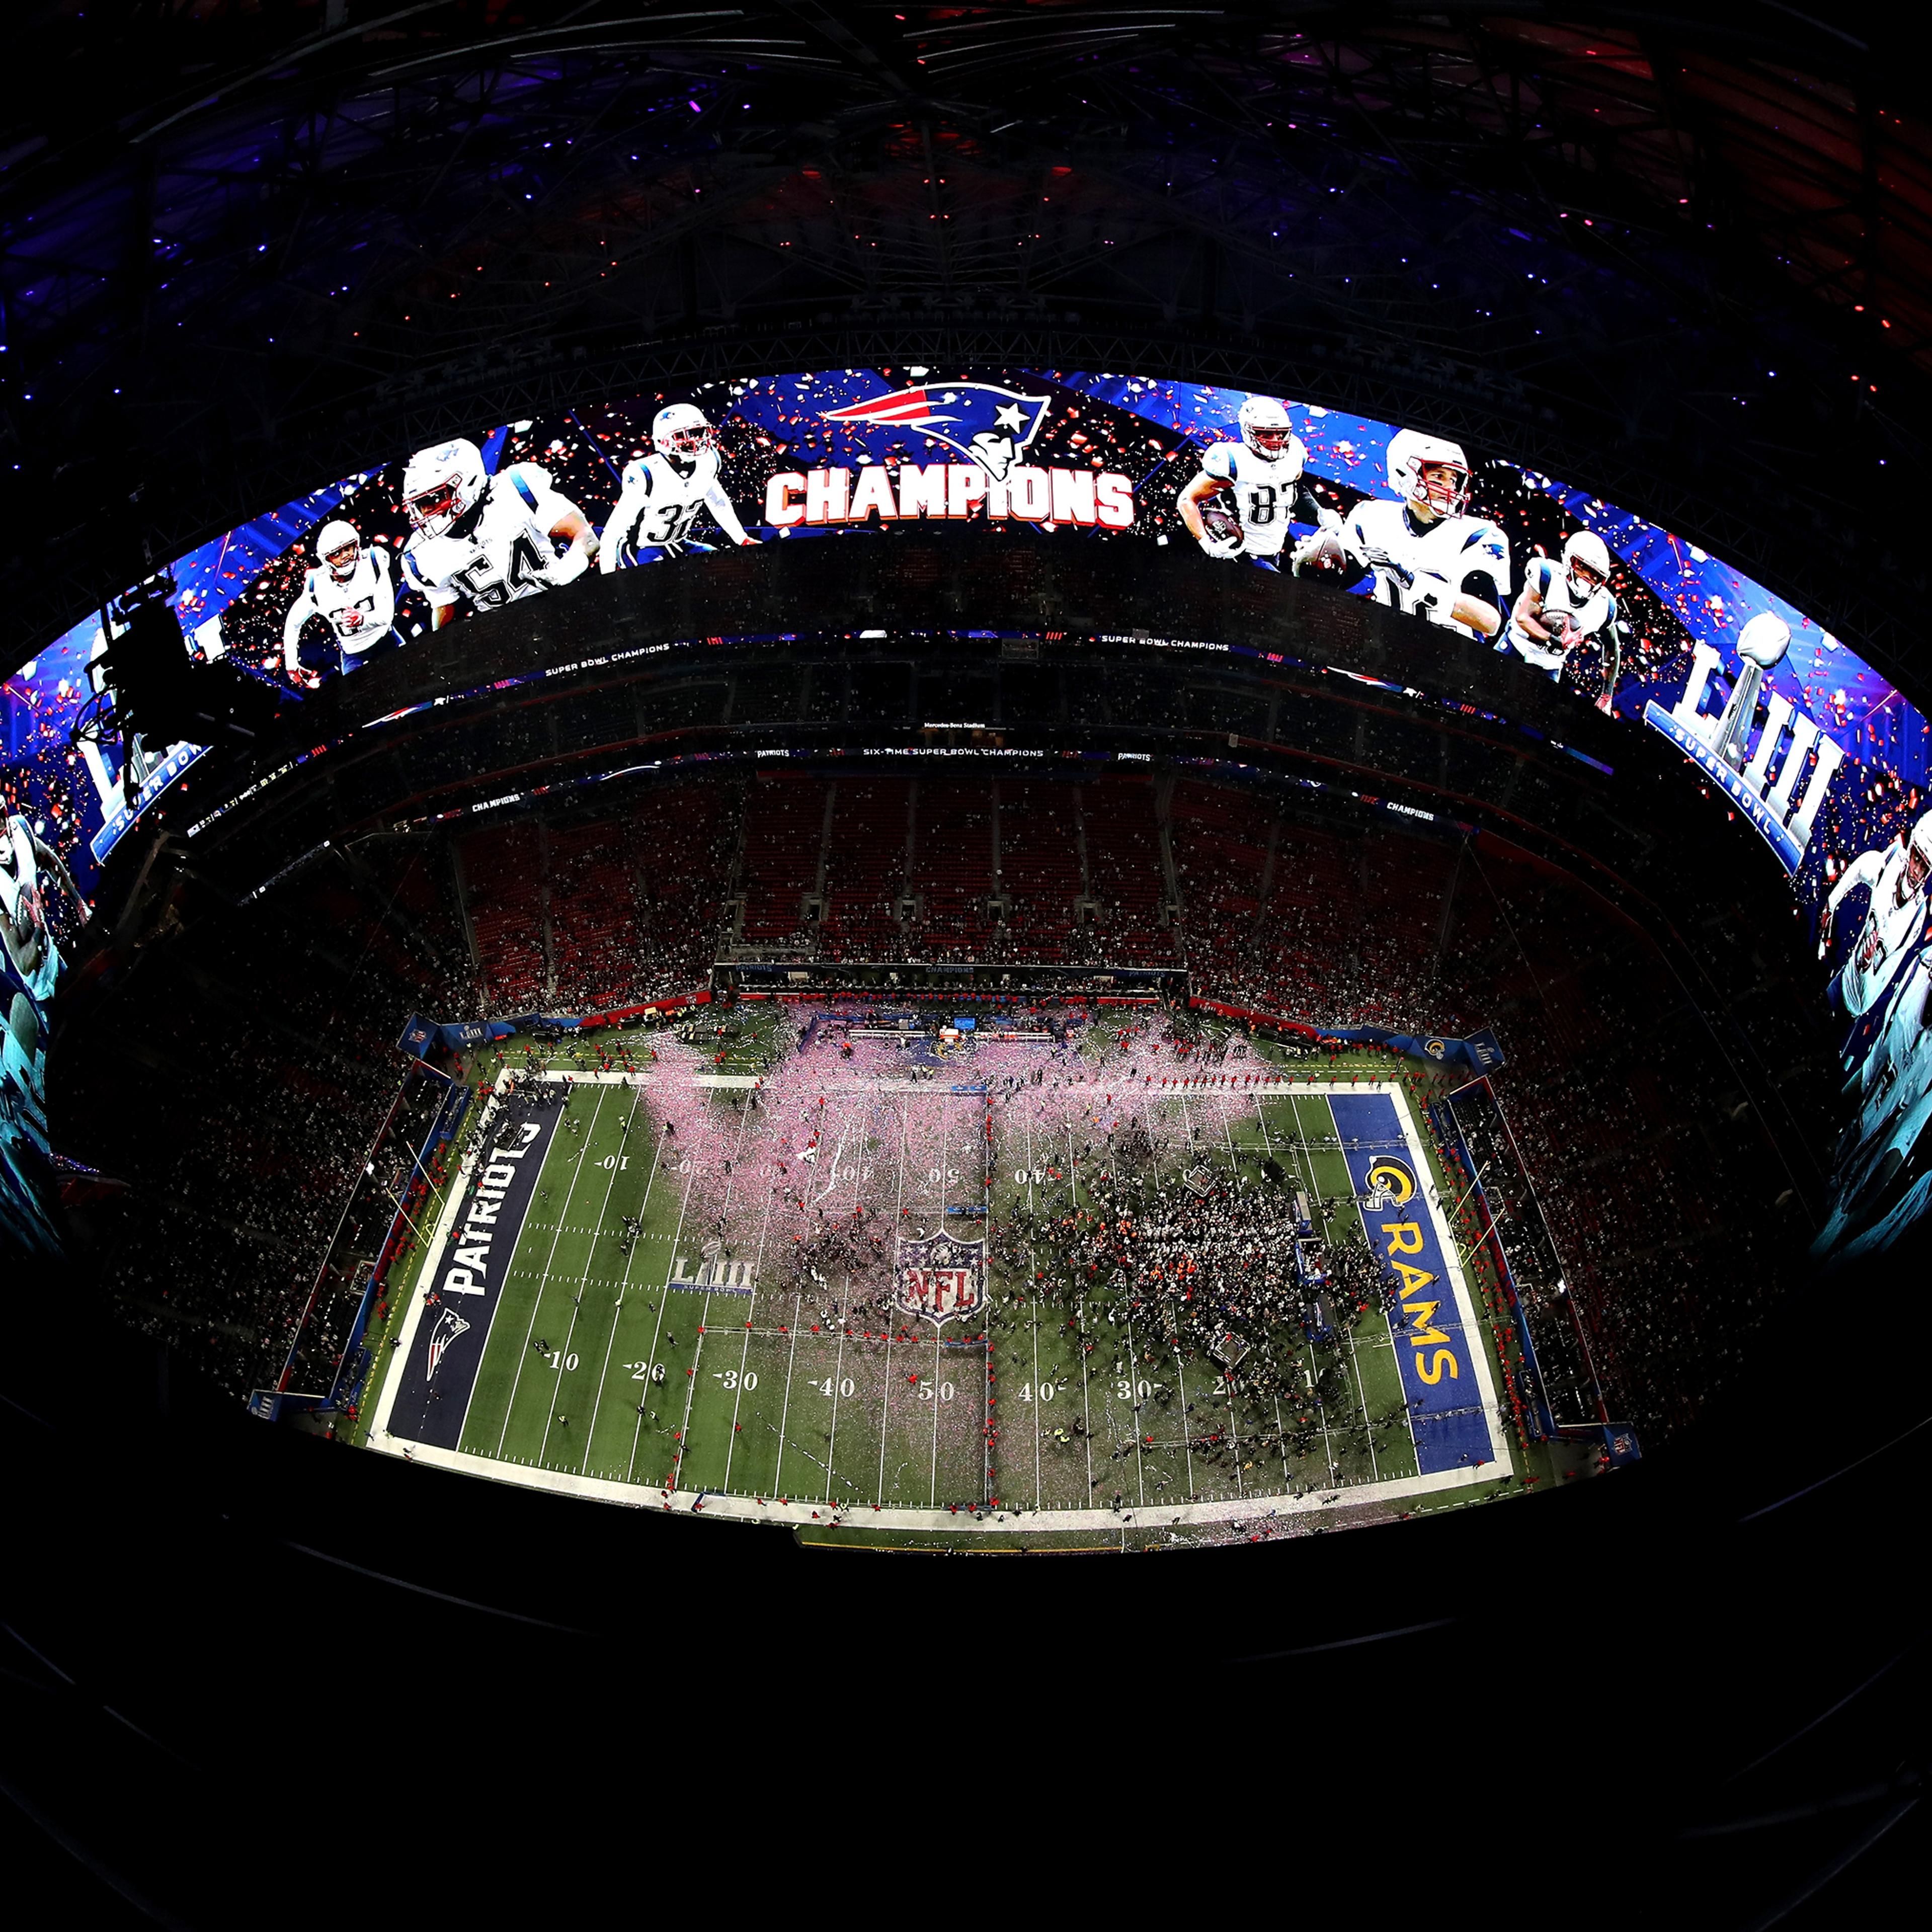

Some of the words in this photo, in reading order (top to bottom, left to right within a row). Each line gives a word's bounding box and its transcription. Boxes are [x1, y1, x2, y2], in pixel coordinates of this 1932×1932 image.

[765, 463, 1134, 529] CHAMPIONS
[1248, 480, 1298, 526] 87
[452, 527, 554, 611] 54
[1102, 635, 1136, 643] SUPER
[1139, 638, 1169, 646] BOWL
[1171, 640, 1229, 651] CHAMPIONS
[545, 663, 578, 676] SUPER
[581, 656, 609, 668] BOWL
[612, 643, 670, 662] CHAMPIONS
[757, 749, 789, 758] PATRIOTS
[1672, 640, 1845, 852] LIII
[167, 744, 202, 777] BOW
[1118, 753, 1150, 761] PATRIOTS
[1674, 728, 1728, 783] SUPER
[1731, 780, 1771, 835] BOWL
[472, 793, 520, 812] CHAMPIONS
[1387, 801, 1434, 821] CHAMPIONS
[603, 1155, 630, 1171] 10
[906, 1269, 975, 1312] NFL
[1381, 1222, 1459, 1385] RAMS
[550, 1351, 579, 1372] 10
[723, 1370, 758, 1391] 30
[819, 1378, 855, 1397] 40
[1116, 1380, 1152, 1400] 30
[918, 1382, 954, 1401] 50
[1018, 1382, 1055, 1402] 40
